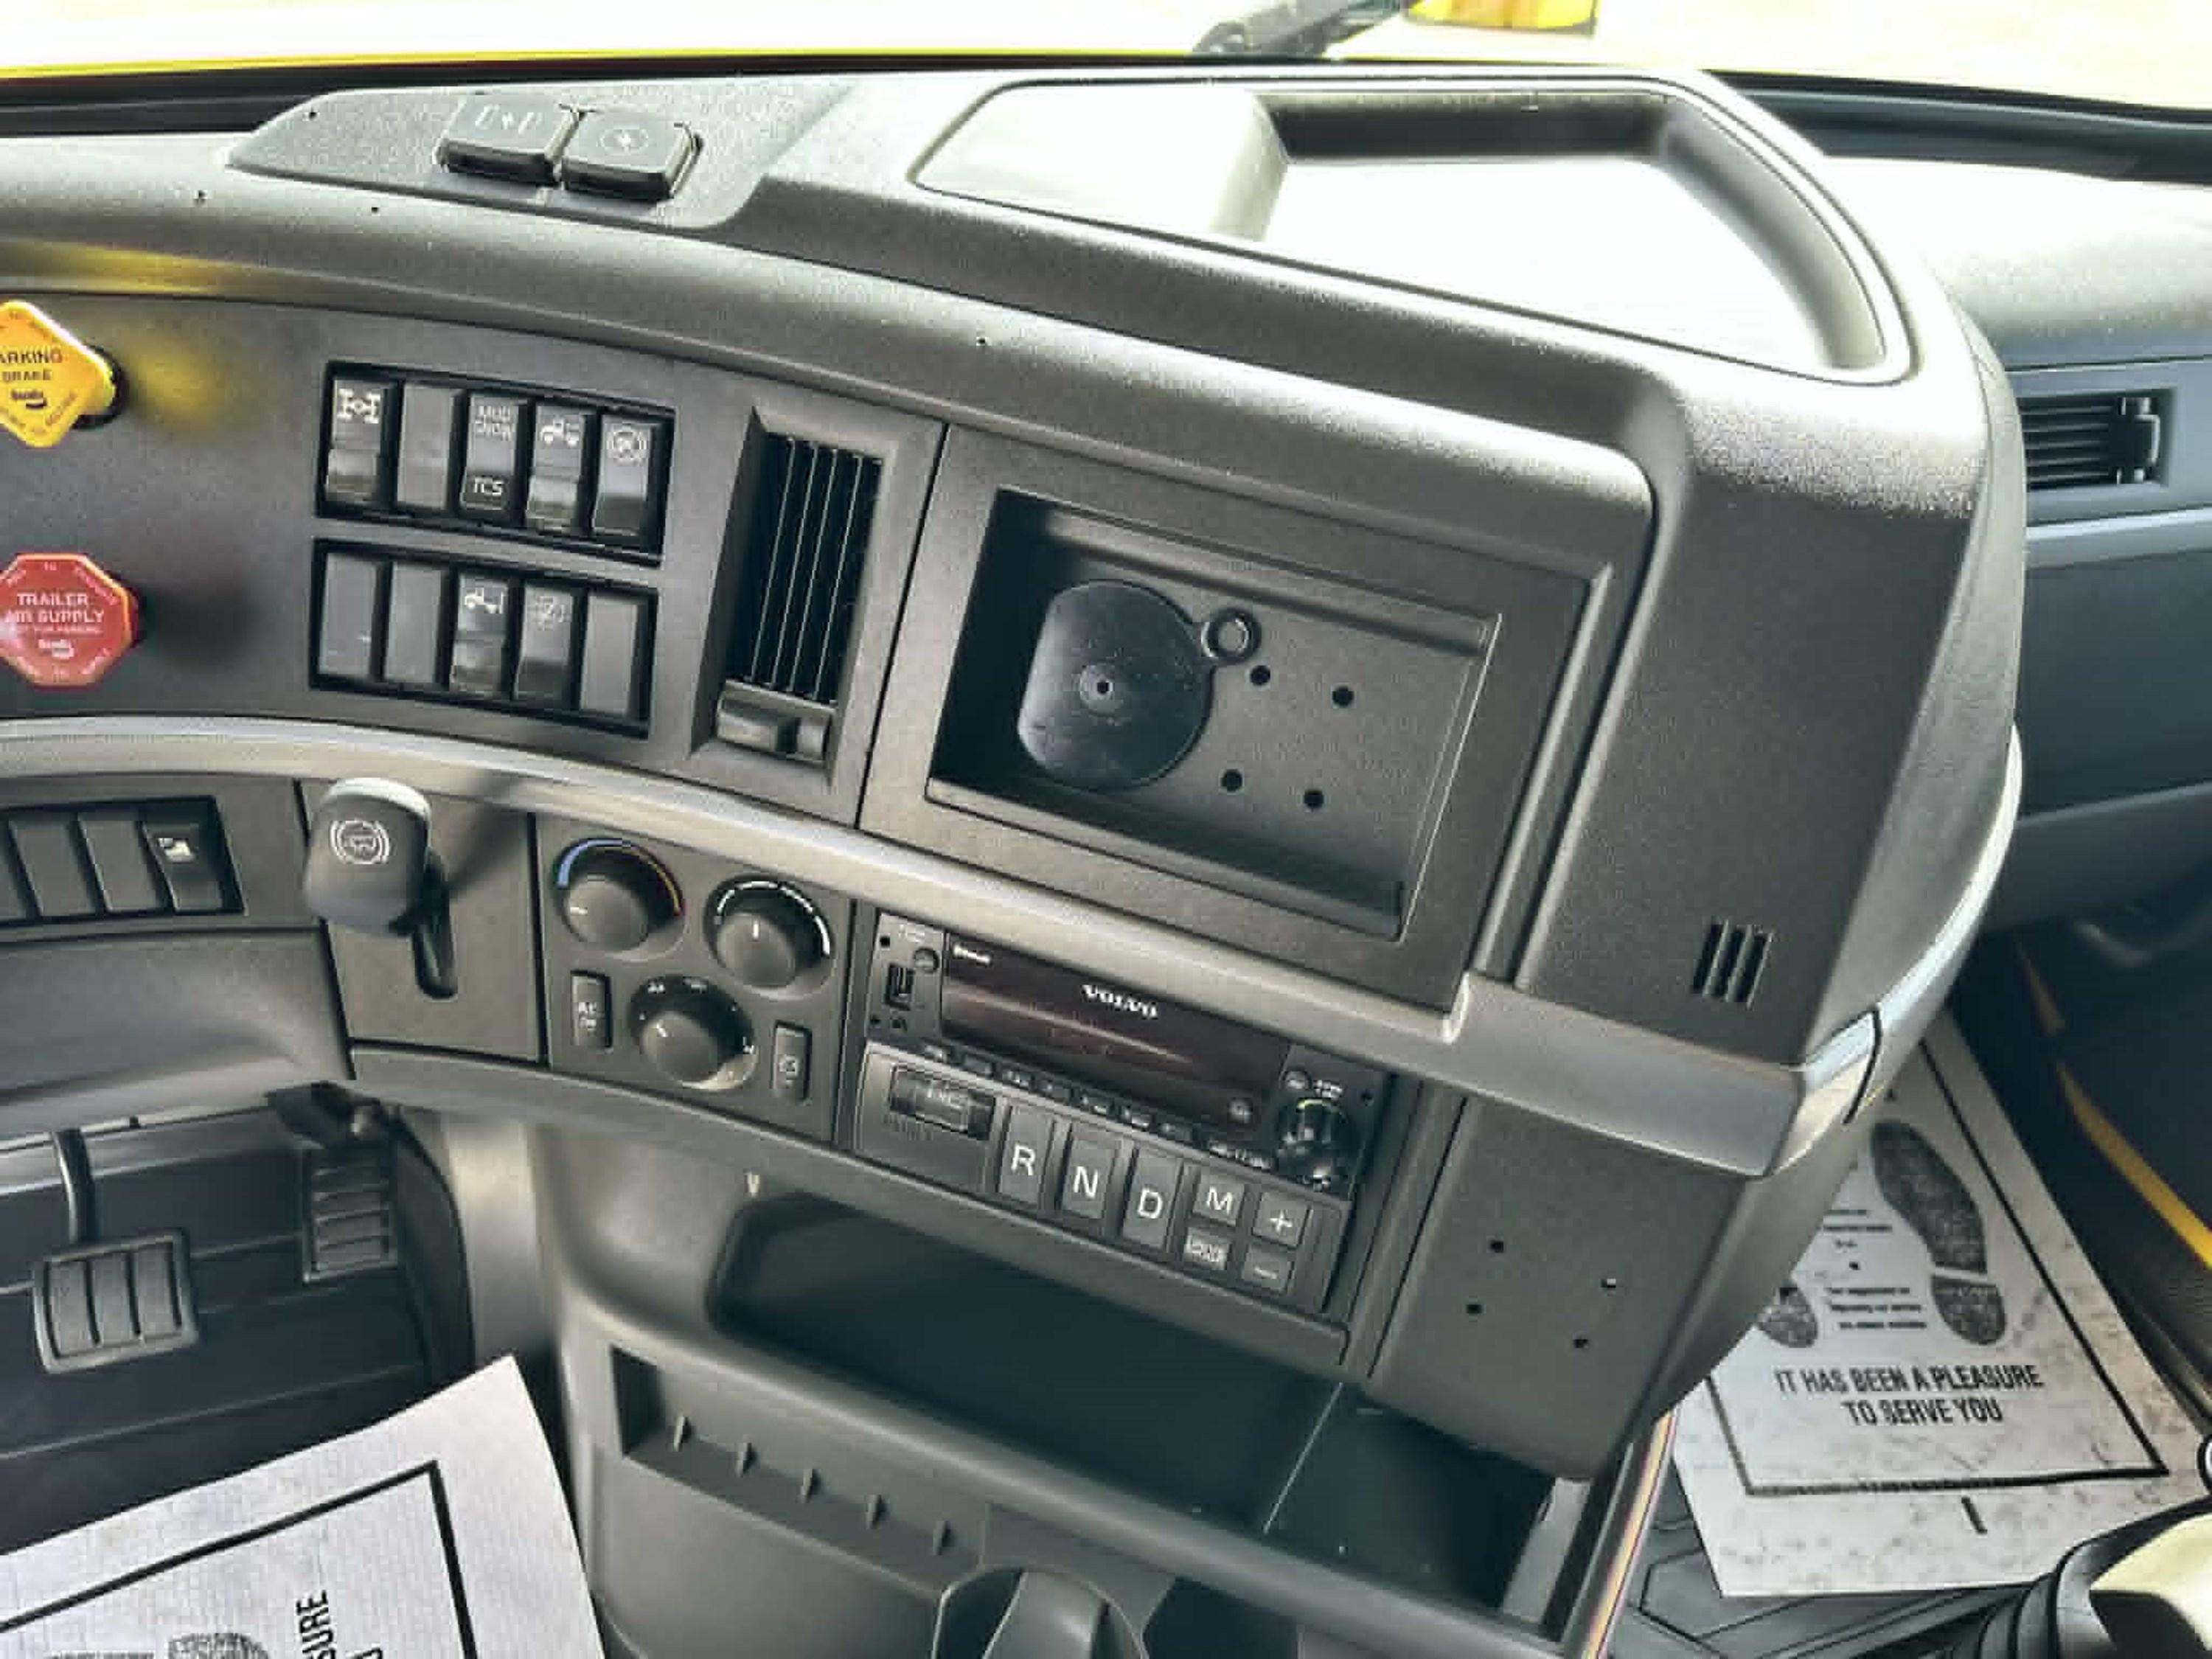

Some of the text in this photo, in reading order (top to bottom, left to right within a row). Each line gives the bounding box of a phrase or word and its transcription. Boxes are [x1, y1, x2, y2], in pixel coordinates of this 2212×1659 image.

[473, 476, 504, 497] TCS
[17, 592, 90, 606] TRAILER
[38, 609, 105, 624] SUPPLY
[1081, 984, 1158, 1018] VOLVO
[1010, 1143, 1036, 1176] R
[1073, 1165, 1099, 1200] N
[1137, 1186, 1164, 1220] D
[1206, 1185, 1234, 1215] M
[1773, 1363, 2045, 1393] IT HAS BEEN A PLEASURE
[1841, 1396, 2003, 1425] TO SERVE YOU
